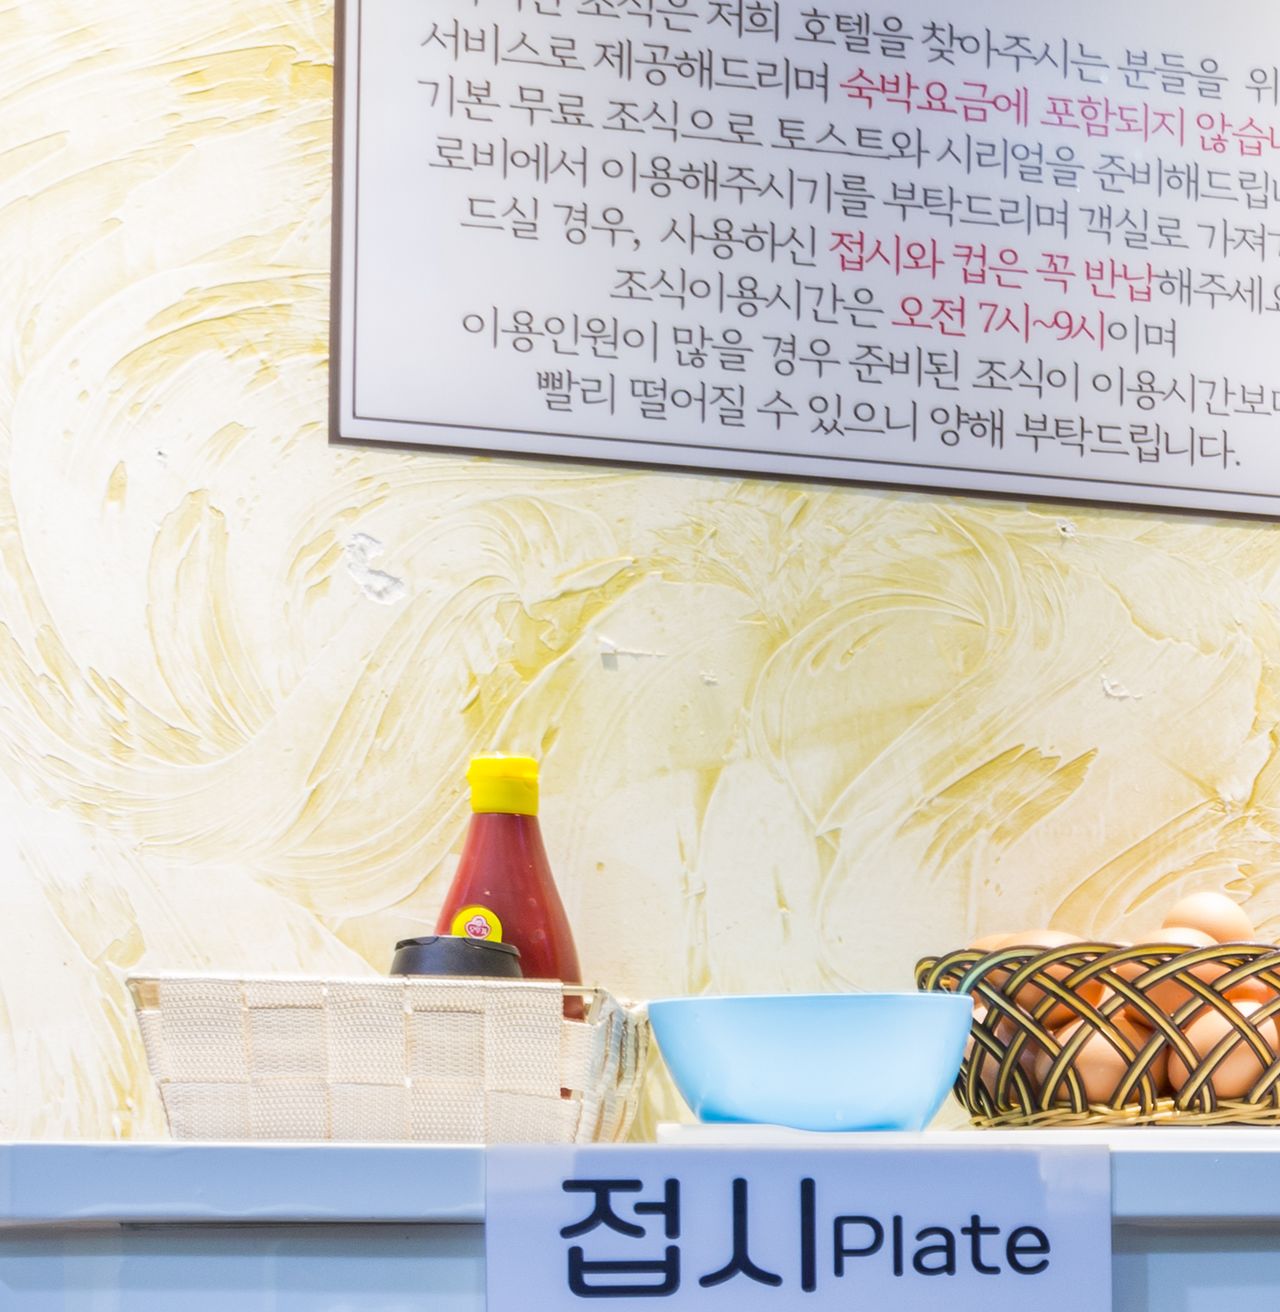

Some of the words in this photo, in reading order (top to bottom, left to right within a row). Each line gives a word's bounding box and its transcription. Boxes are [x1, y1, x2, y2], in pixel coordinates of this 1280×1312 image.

[422, 19, 586, 71] 서비스로
[594, 39, 828, 104] 제공해드리며
[840, 68, 1028, 127] 숙박요금에
[1040, 96, 1184, 146] 포함되지
[707, 0, 779, 43] 저희
[795, 8, 913, 59] 호텔을
[922, 21, 1109, 83] 찾아주시는
[1118, 50, 1228, 99] 분들을
[418, 75, 501, 122] 기본
[510, 86, 595, 128] 무료
[603, 100, 763, 146] 조식으로
[771, 118, 930, 168] 토스트와
[937, 134, 1084, 187] 시리얼을
[429, 137, 587, 188] 로비에서
[602, 152, 875, 218] 이용해주시기를
[883, 182, 1067, 239] 부탁드리며
[1079, 205, 1188, 250] 객실로
[461, 197, 538, 240] 드실
[554, 202, 640, 251] 경우,
[661, 213, 816, 267] 사용하신
[830, 231, 944, 279] 접시와
[953, 244, 1028, 289] 컵은
[1036, 253, 1075, 293] 꼭
[610, 268, 884, 328] 조식이용시간은
[892, 296, 965, 337] 오전
[463, 306, 657, 363] 이용인원이
[673, 325, 753, 372] 많을
[763, 334, 840, 378] 경우
[849, 344, 959, 391] 준비된
[972, 358, 1078, 401] 조식이
[537, 369, 614, 415] 빨리
[630, 378, 745, 427] 떨어질
[757, 390, 799, 430] 수
[809, 394, 916, 442] 있으니
[930, 404, 1003, 449] 양해
[1016, 413, 1240, 469] 부탁드립니다.
